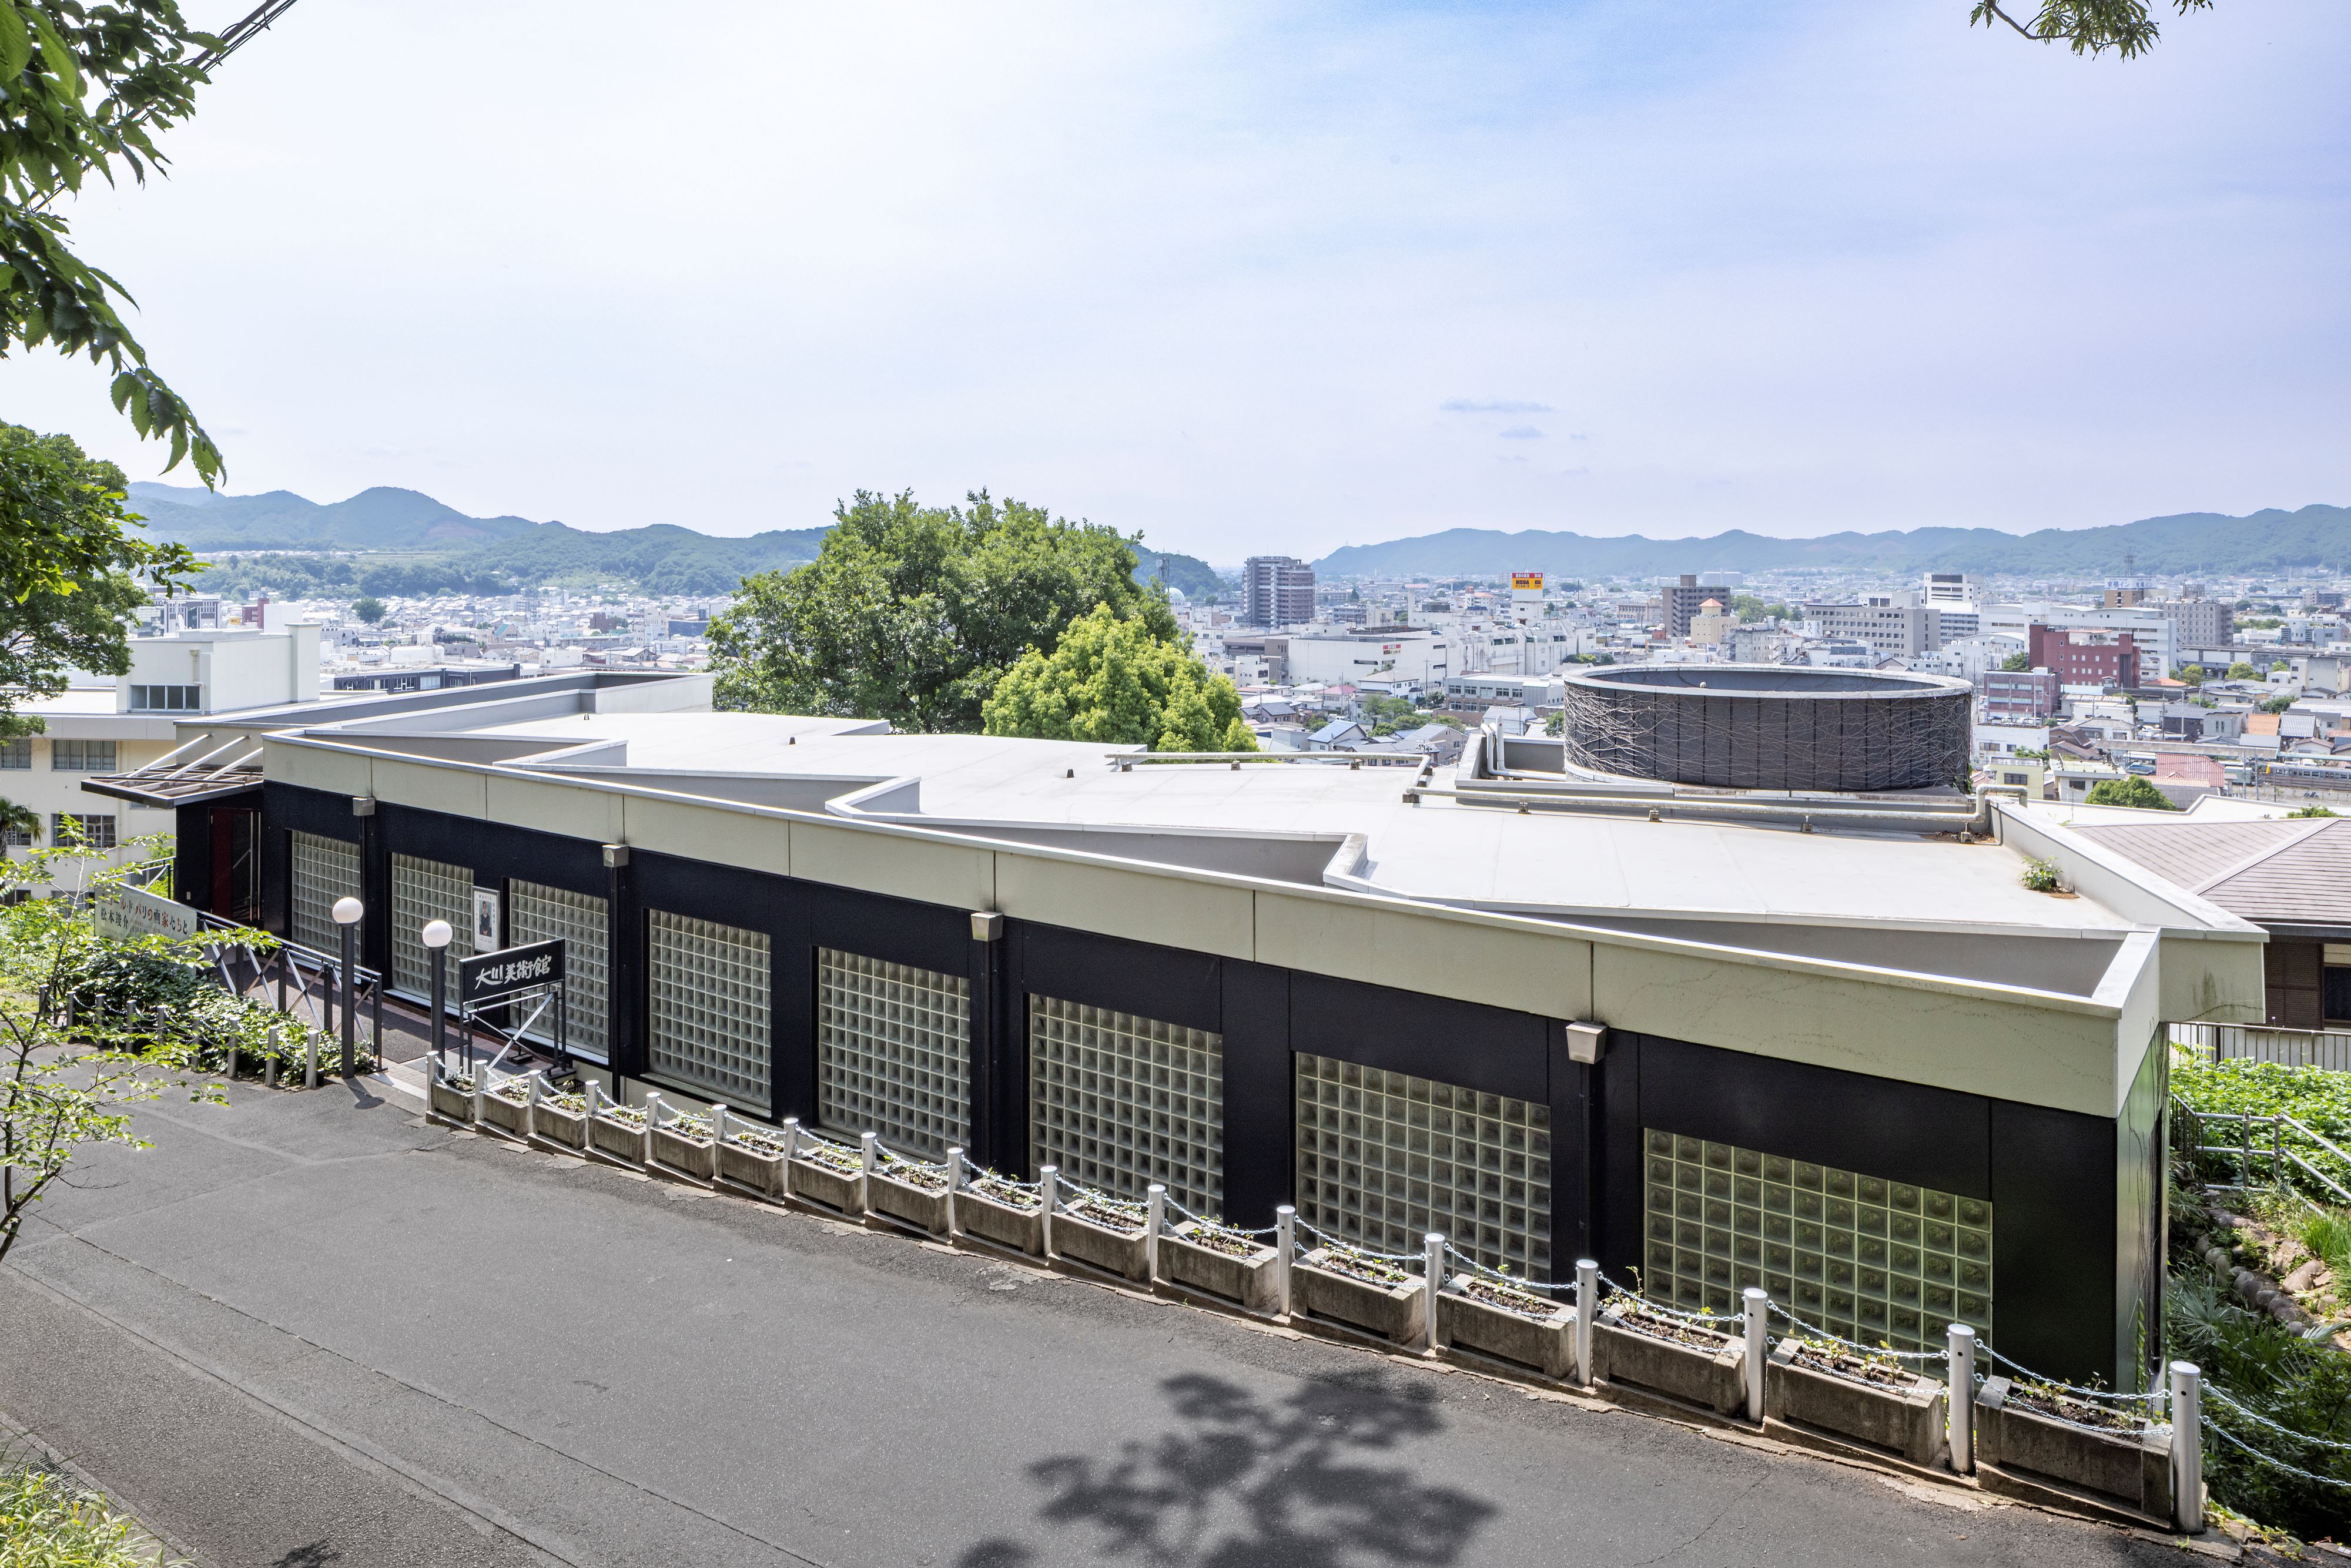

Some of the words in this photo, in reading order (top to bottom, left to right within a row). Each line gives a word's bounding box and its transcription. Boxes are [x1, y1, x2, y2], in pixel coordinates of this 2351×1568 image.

[475, 954, 552, 990] 大川美術館
